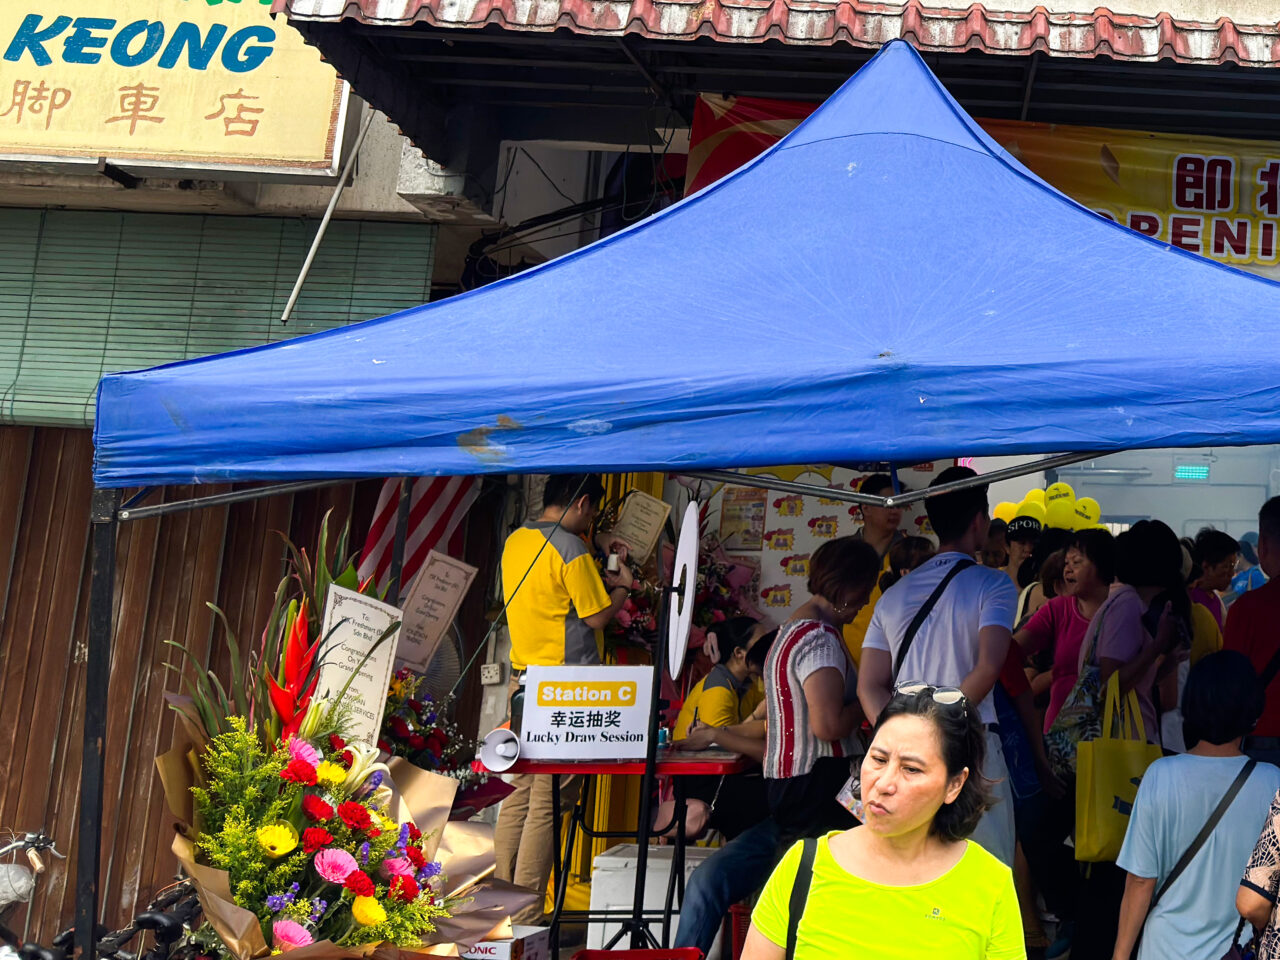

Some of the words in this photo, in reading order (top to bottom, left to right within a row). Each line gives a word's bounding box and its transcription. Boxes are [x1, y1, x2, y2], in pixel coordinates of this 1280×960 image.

[3, 13, 276, 73] KEONG
[0, 79, 265, 137] 脚車店
[542, 686, 611, 701] Station
[618, 686, 632, 701] C
[550, 710, 621, 728] 幸运抽奖
[526, 731, 561, 745] Lucky
[565, 732, 597, 743] Draw
[600, 731, 644, 743] Session
